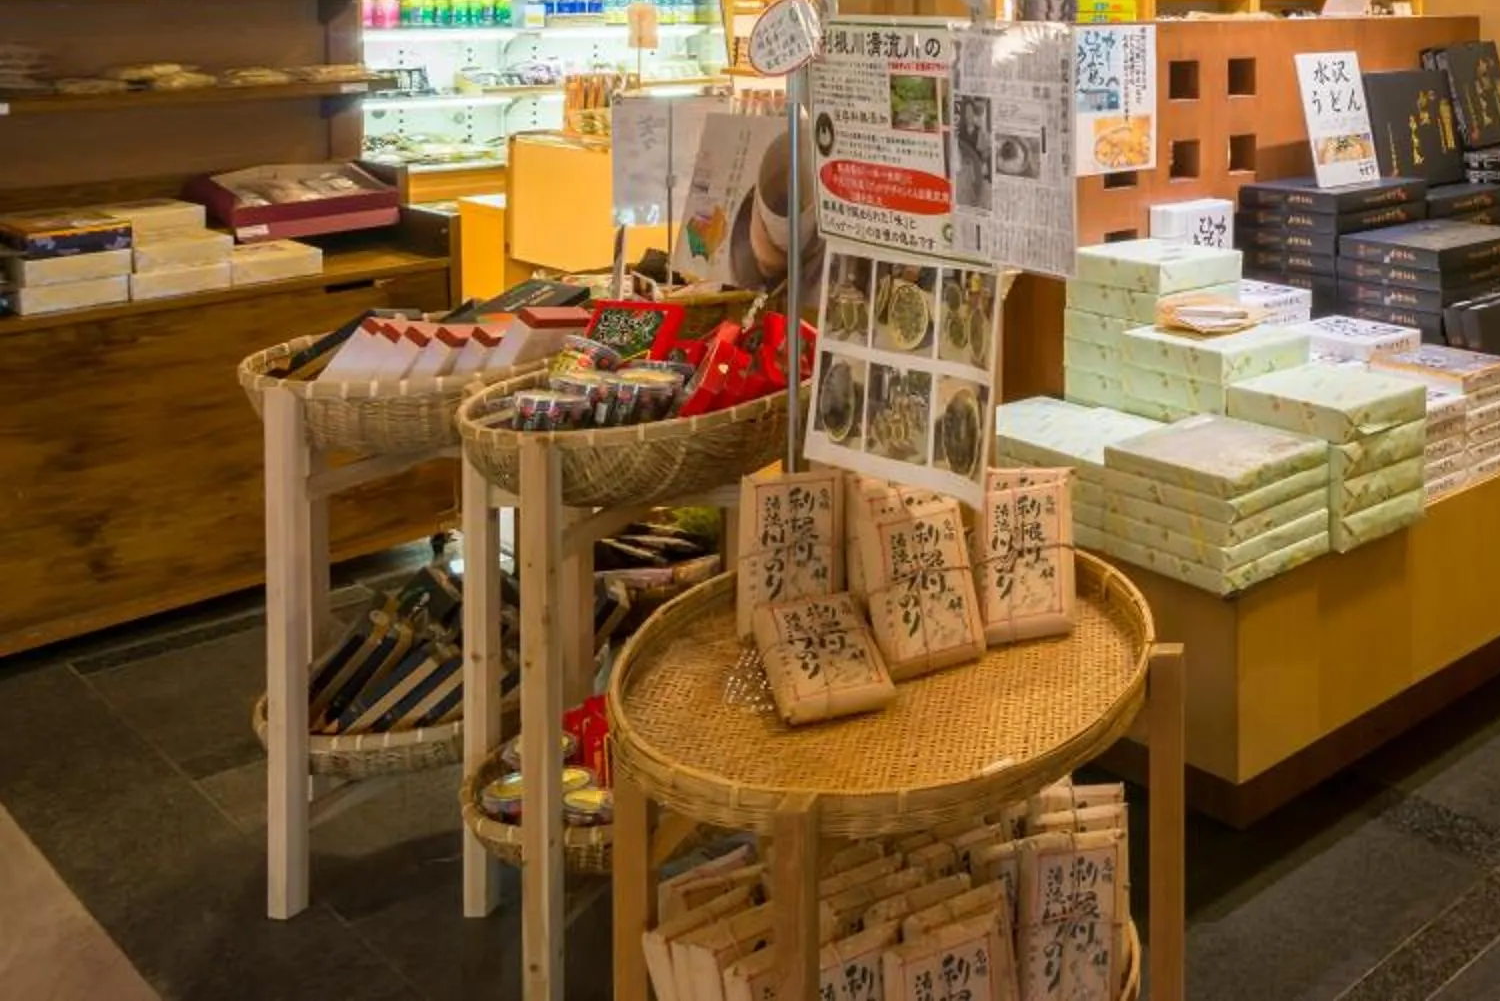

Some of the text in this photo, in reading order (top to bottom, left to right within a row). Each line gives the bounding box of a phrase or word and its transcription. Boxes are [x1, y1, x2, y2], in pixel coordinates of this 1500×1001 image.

[1313, 60, 1350, 85] 水沢
[1311, 88, 1362, 115] うどん
